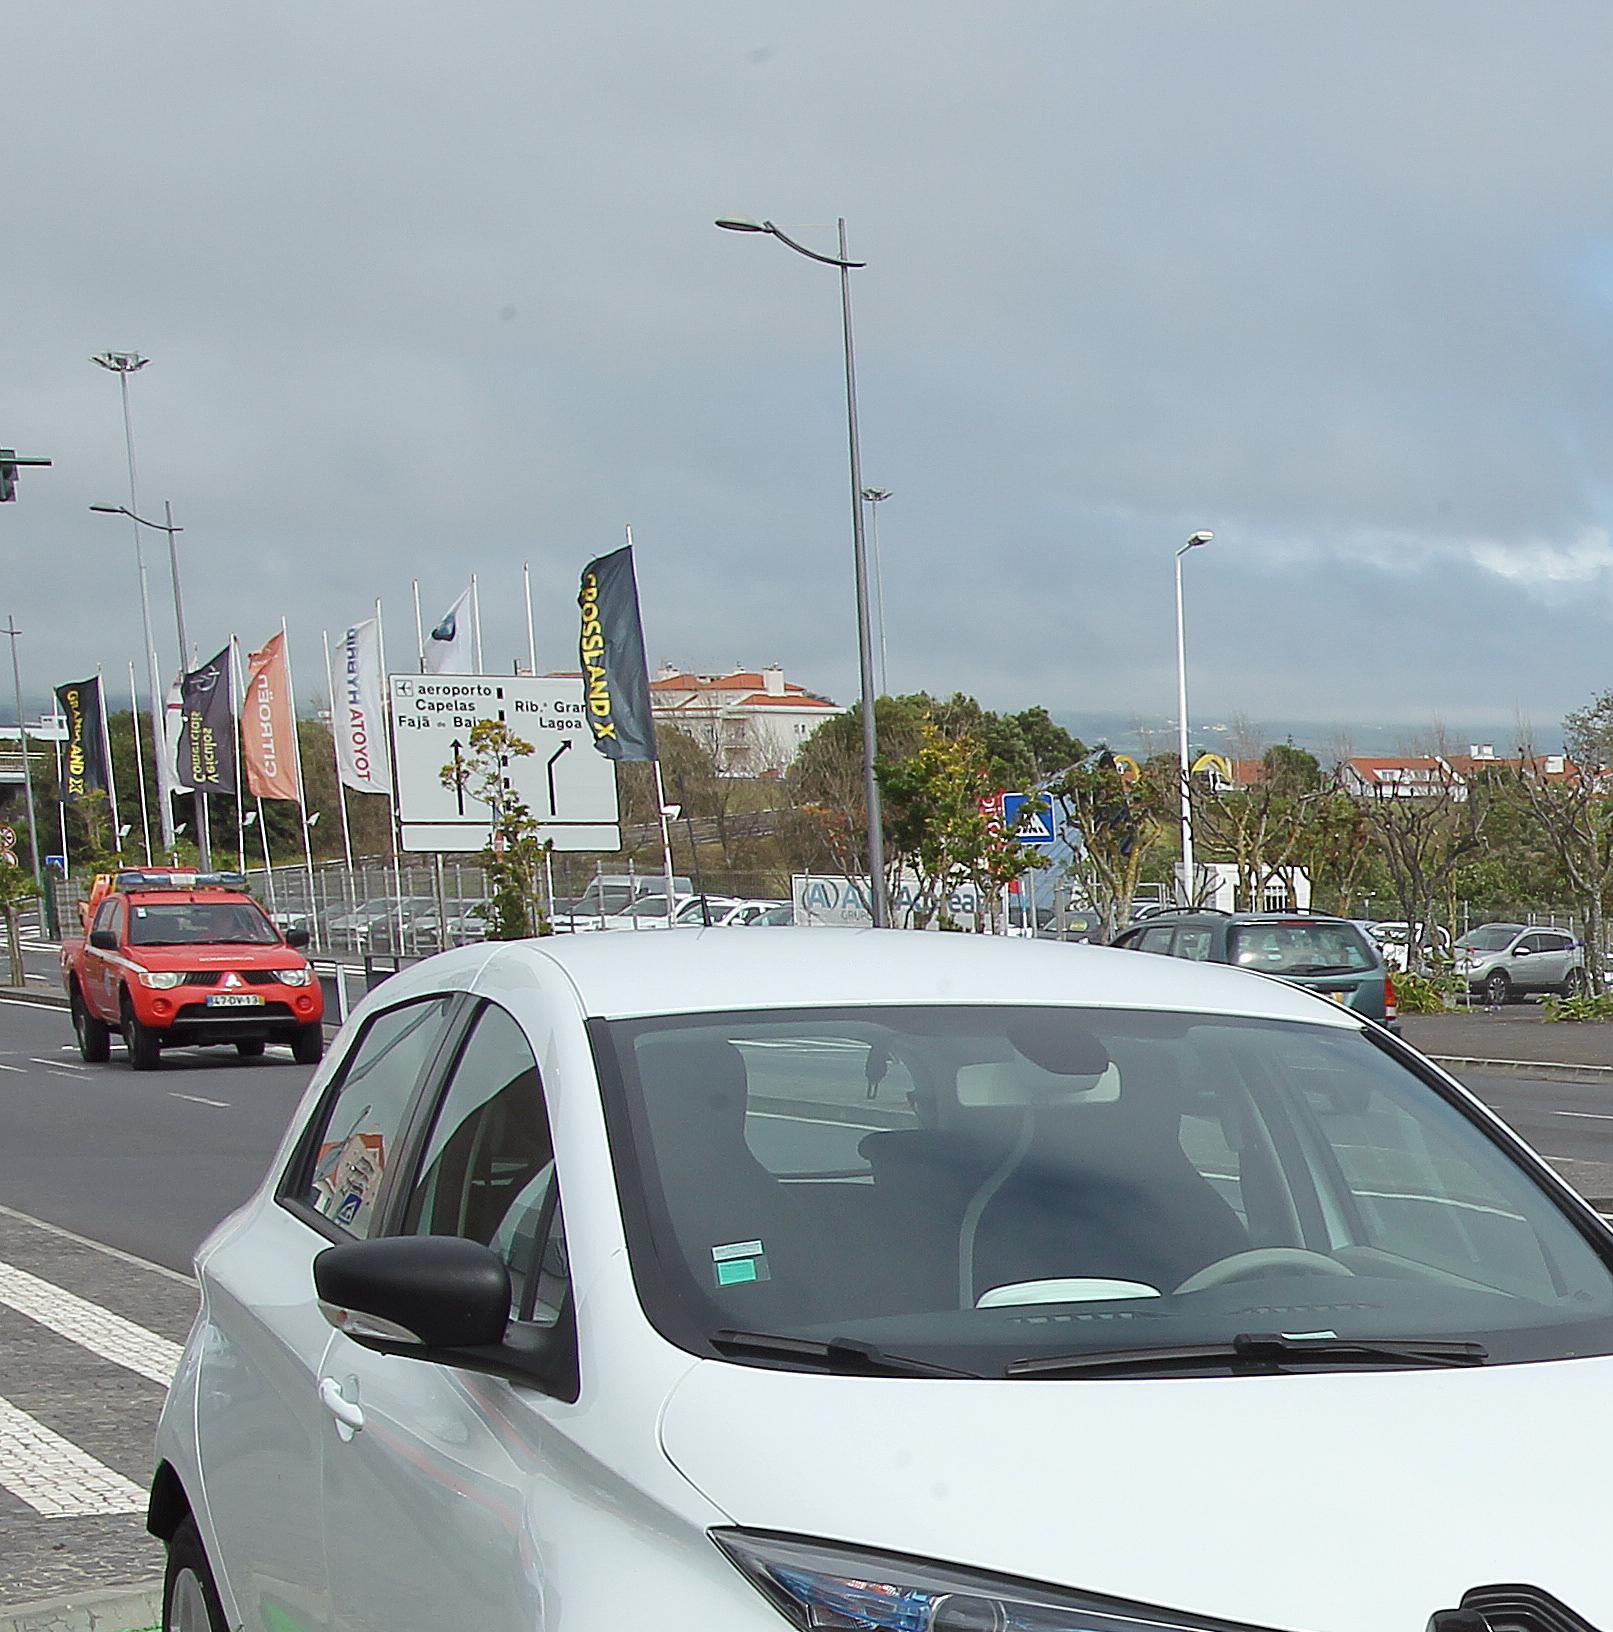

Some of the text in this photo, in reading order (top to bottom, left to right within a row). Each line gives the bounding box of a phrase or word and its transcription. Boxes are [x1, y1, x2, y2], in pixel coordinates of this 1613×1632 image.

[418, 684, 492, 697] aeroporto
[415, 699, 476, 713] Capelas
[398, 715, 430, 729] Fajã
[539, 716, 582, 731] Lagoa
[593, 721, 617, 741] X
